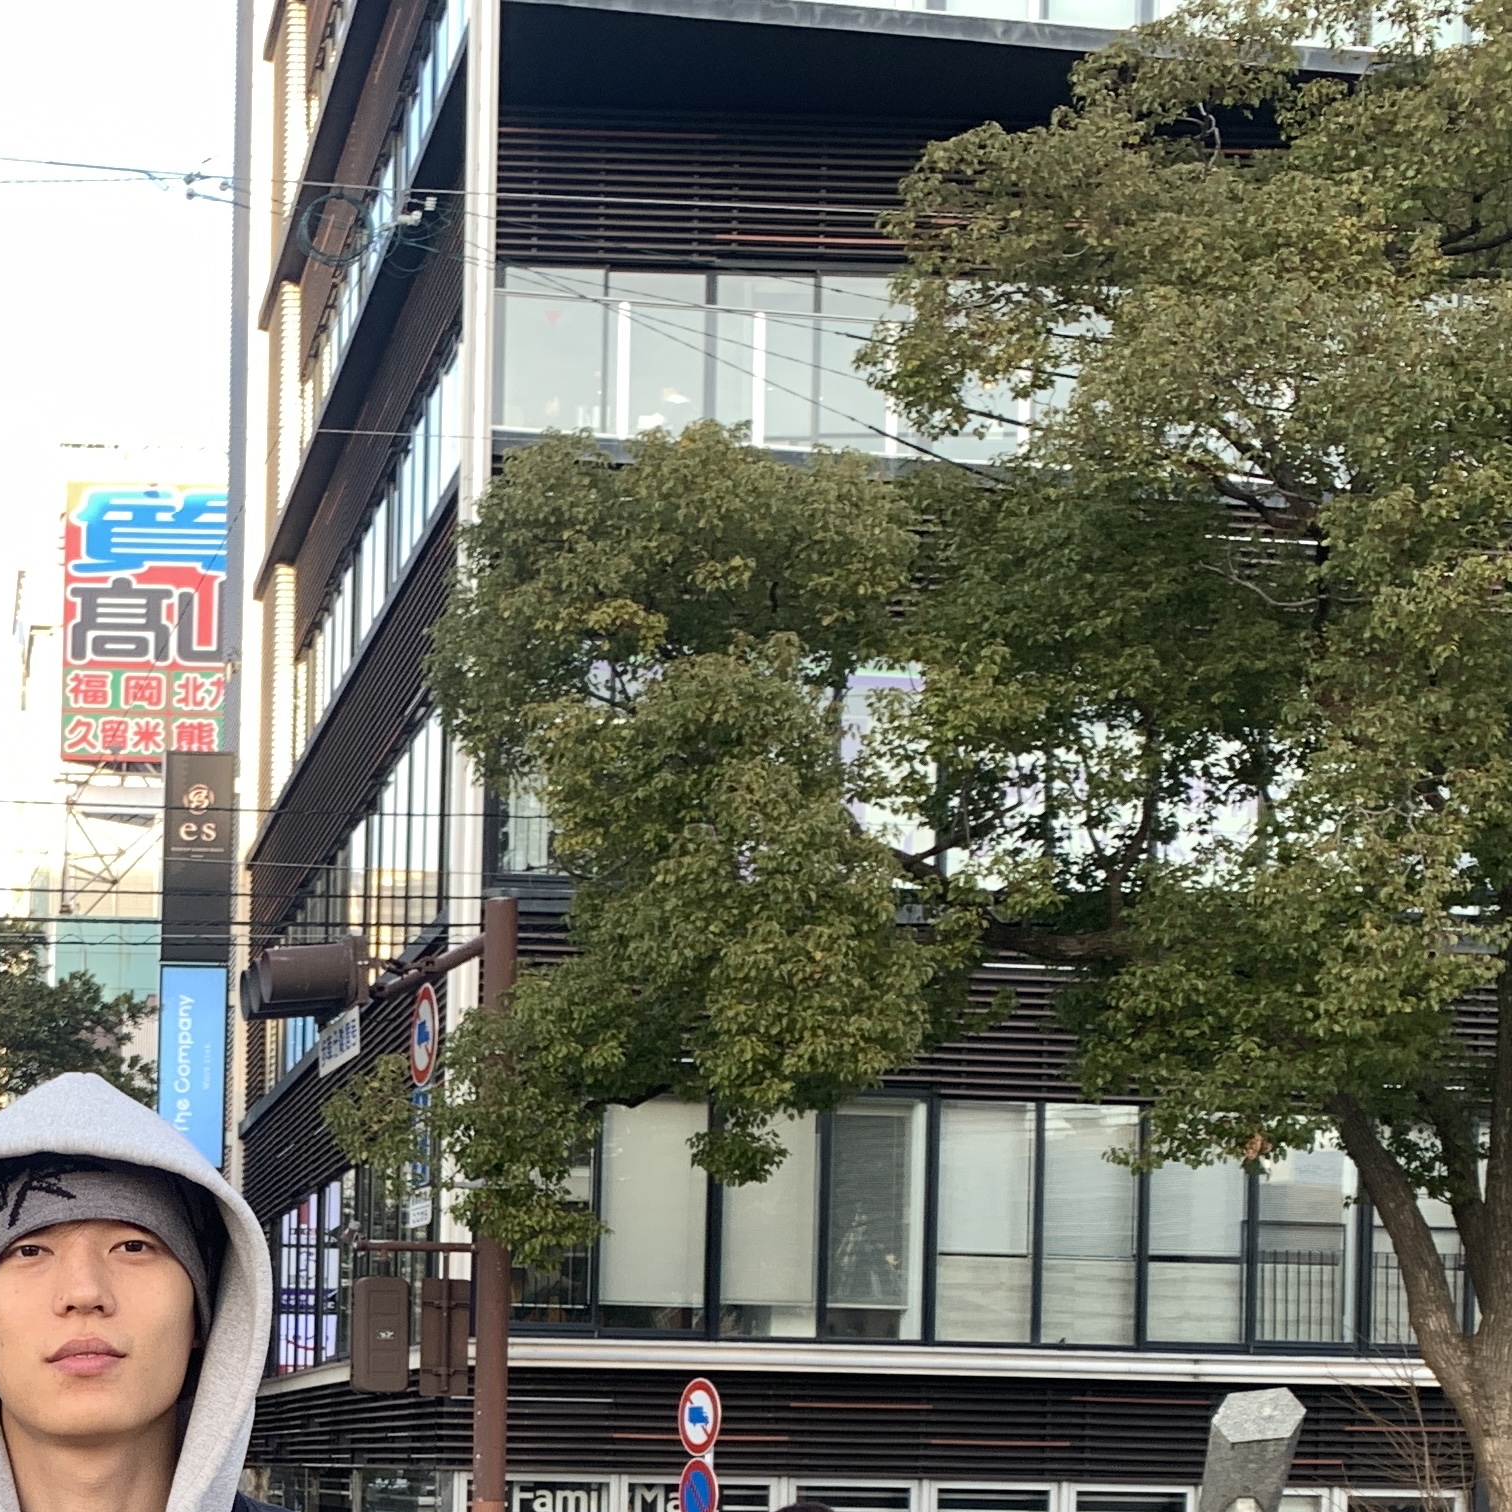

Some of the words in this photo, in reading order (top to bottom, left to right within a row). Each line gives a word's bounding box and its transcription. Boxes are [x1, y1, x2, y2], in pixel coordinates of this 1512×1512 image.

[66, 673, 164, 708] 福岡
[66, 718, 165, 752] 久留米
[178, 819, 217, 841] es
[174, 994, 195, 1093] Company
